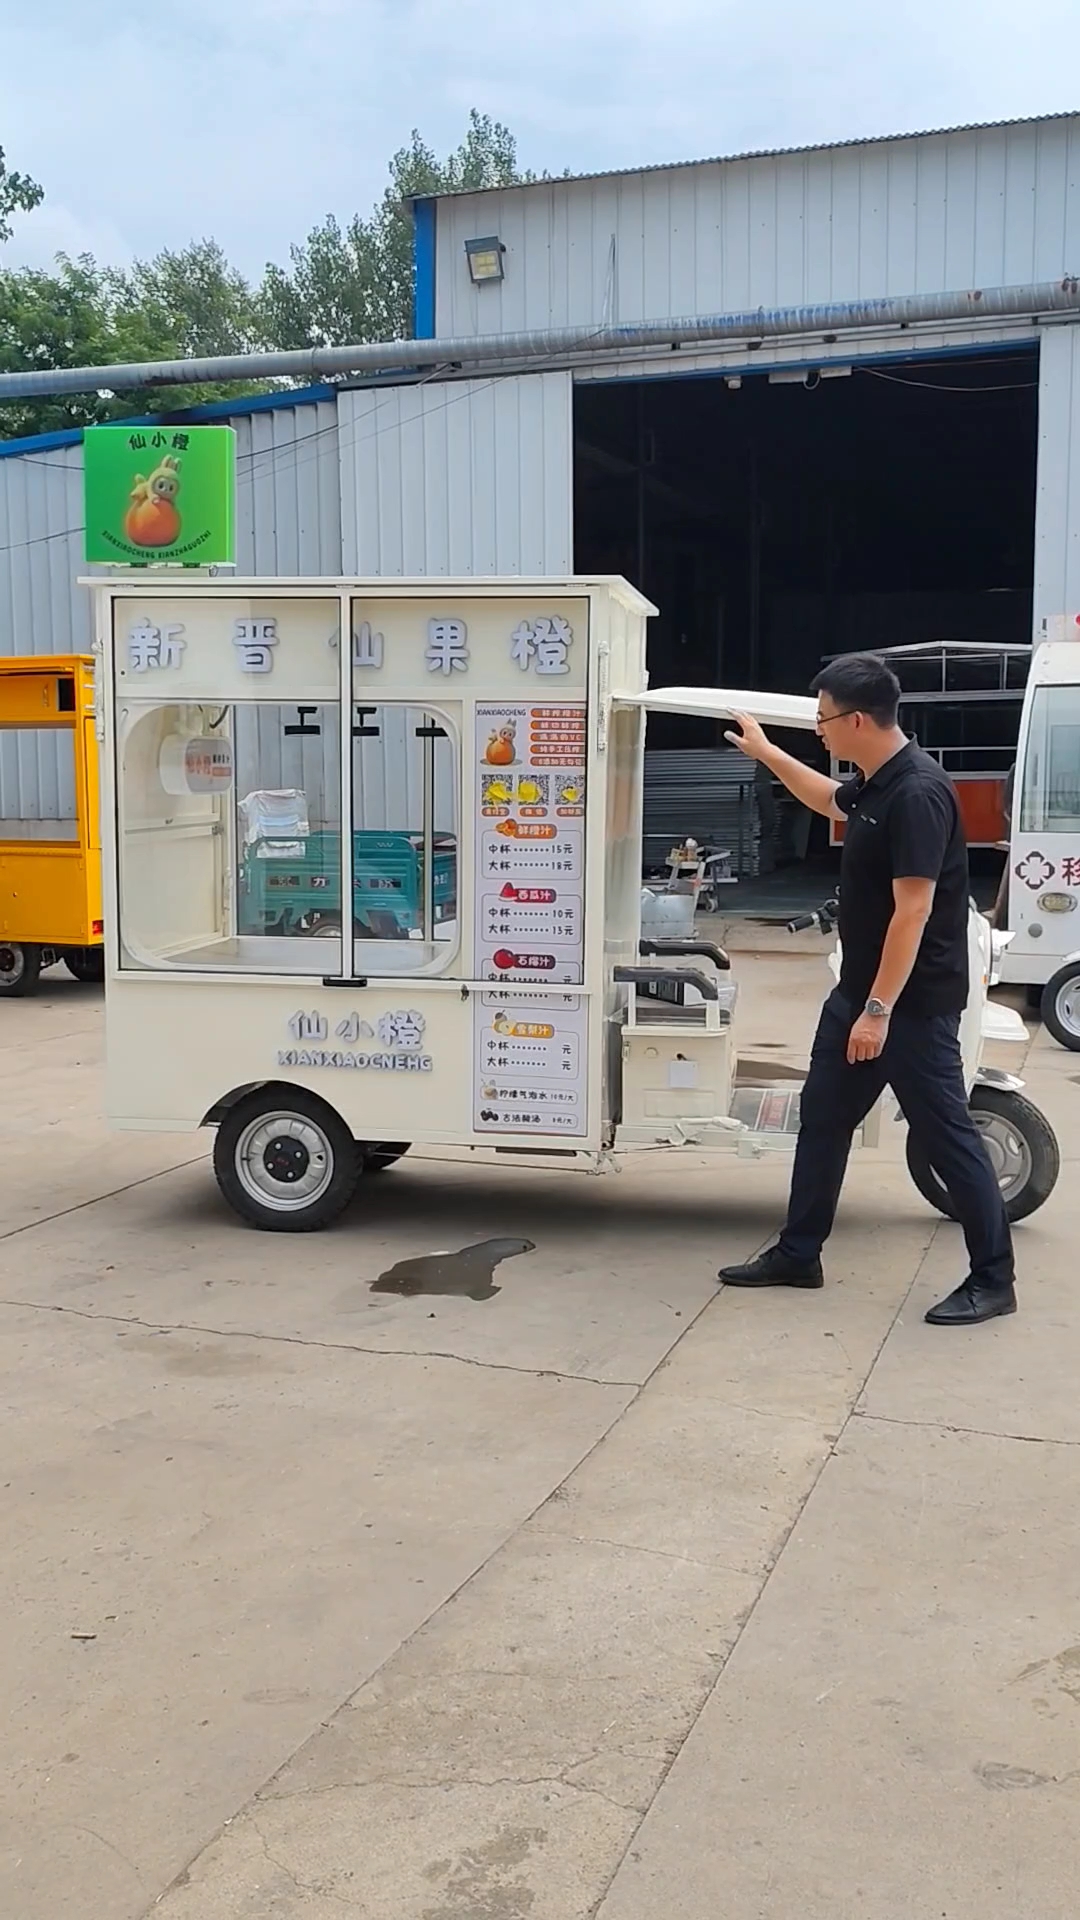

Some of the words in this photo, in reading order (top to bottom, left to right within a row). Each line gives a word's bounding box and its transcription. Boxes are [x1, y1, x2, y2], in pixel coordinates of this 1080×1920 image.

[129, 432, 190, 450] 仙小橙
[488, 844, 511, 854] 中杯
[551, 843, 573, 854] 15元
[488, 861, 511, 871] 大杯
[518, 889, 551, 900] 西瓜汁
[488, 907, 511, 918] 中杯
[552, 908, 574, 918] 10元
[488, 924, 511, 935] 大杯
[288, 1009, 426, 1051] 仙小橙
[487, 1041, 509, 1051] 中杯
[486, 1057, 509, 1067] 大杯
